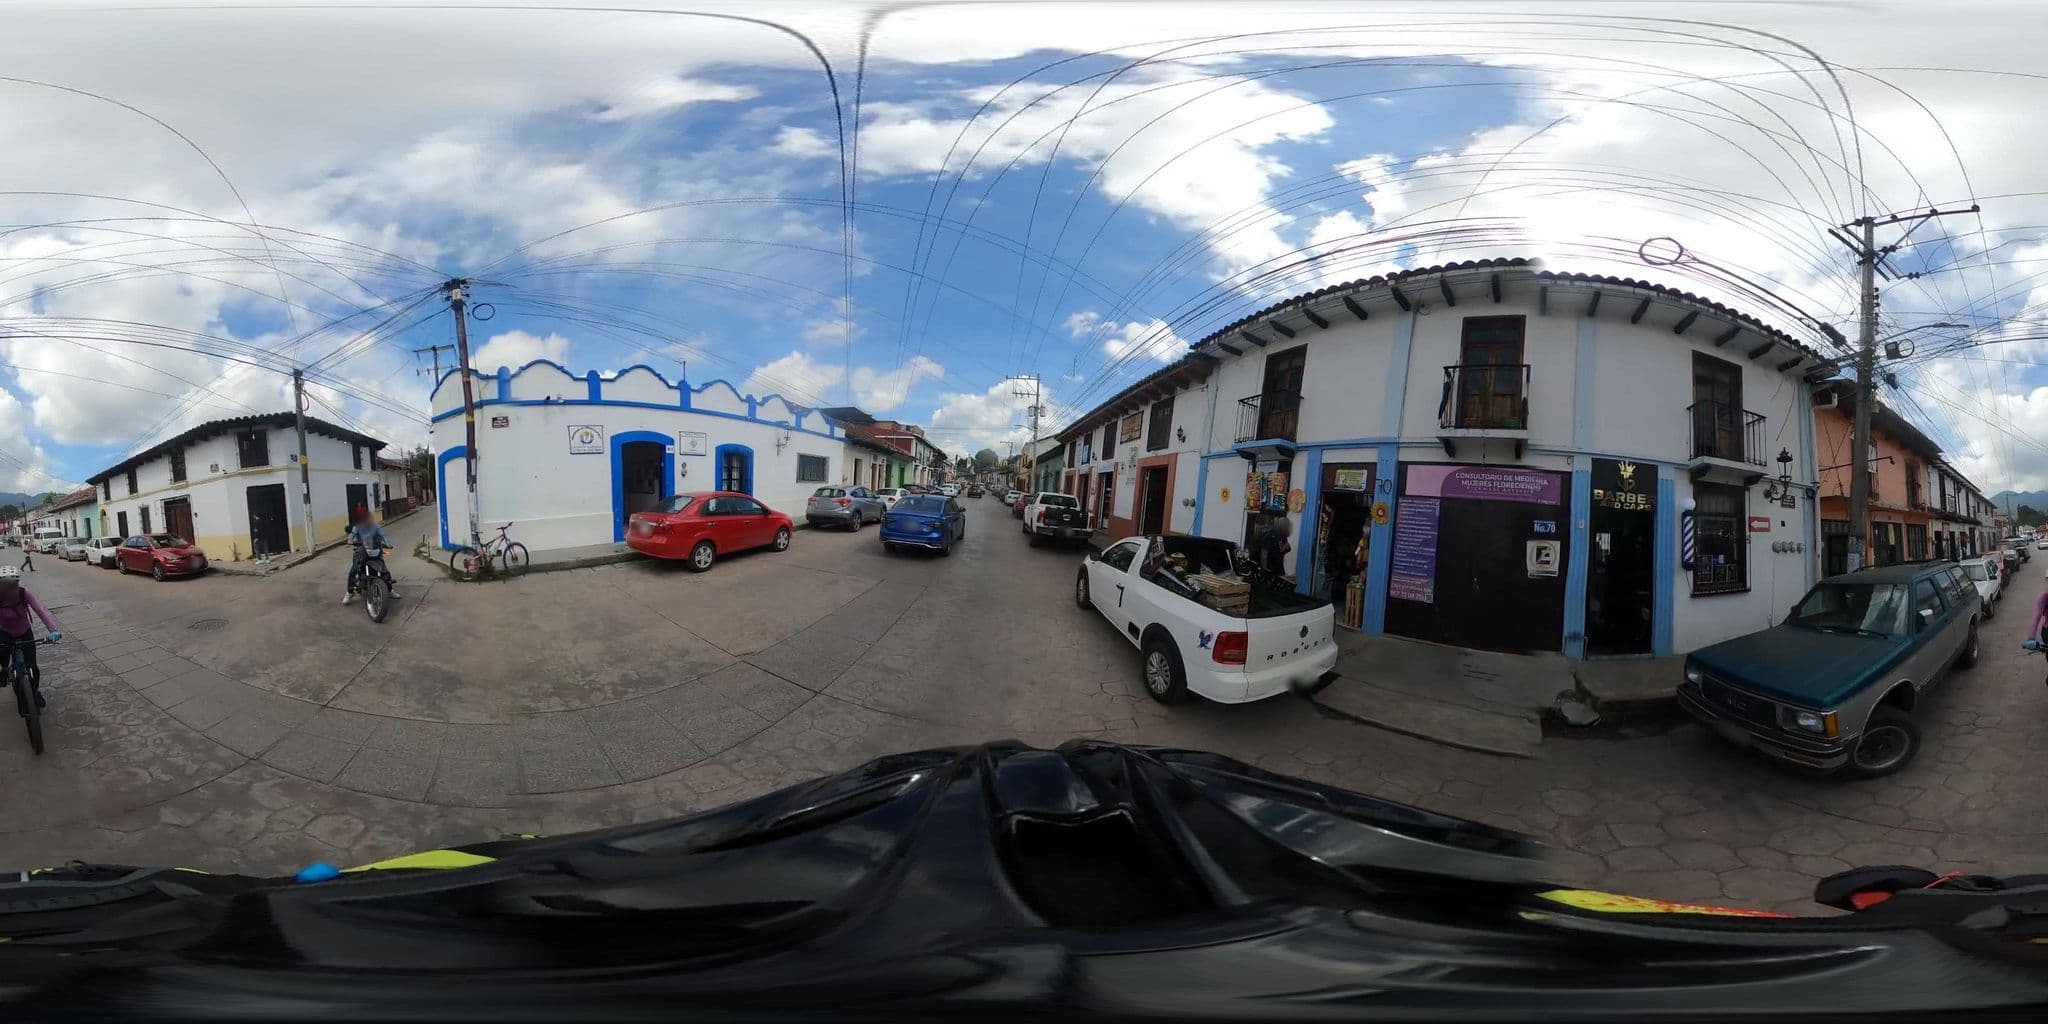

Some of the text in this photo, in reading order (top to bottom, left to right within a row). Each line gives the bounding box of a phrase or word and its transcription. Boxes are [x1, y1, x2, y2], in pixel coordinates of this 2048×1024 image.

[1455, 472, 1502, 481] CONSULTORIO
[1375, 478, 1393, 495] 70
[1461, 479, 1492, 488] MUJERES
[1266, 637, 1327, 661] ROBUST
